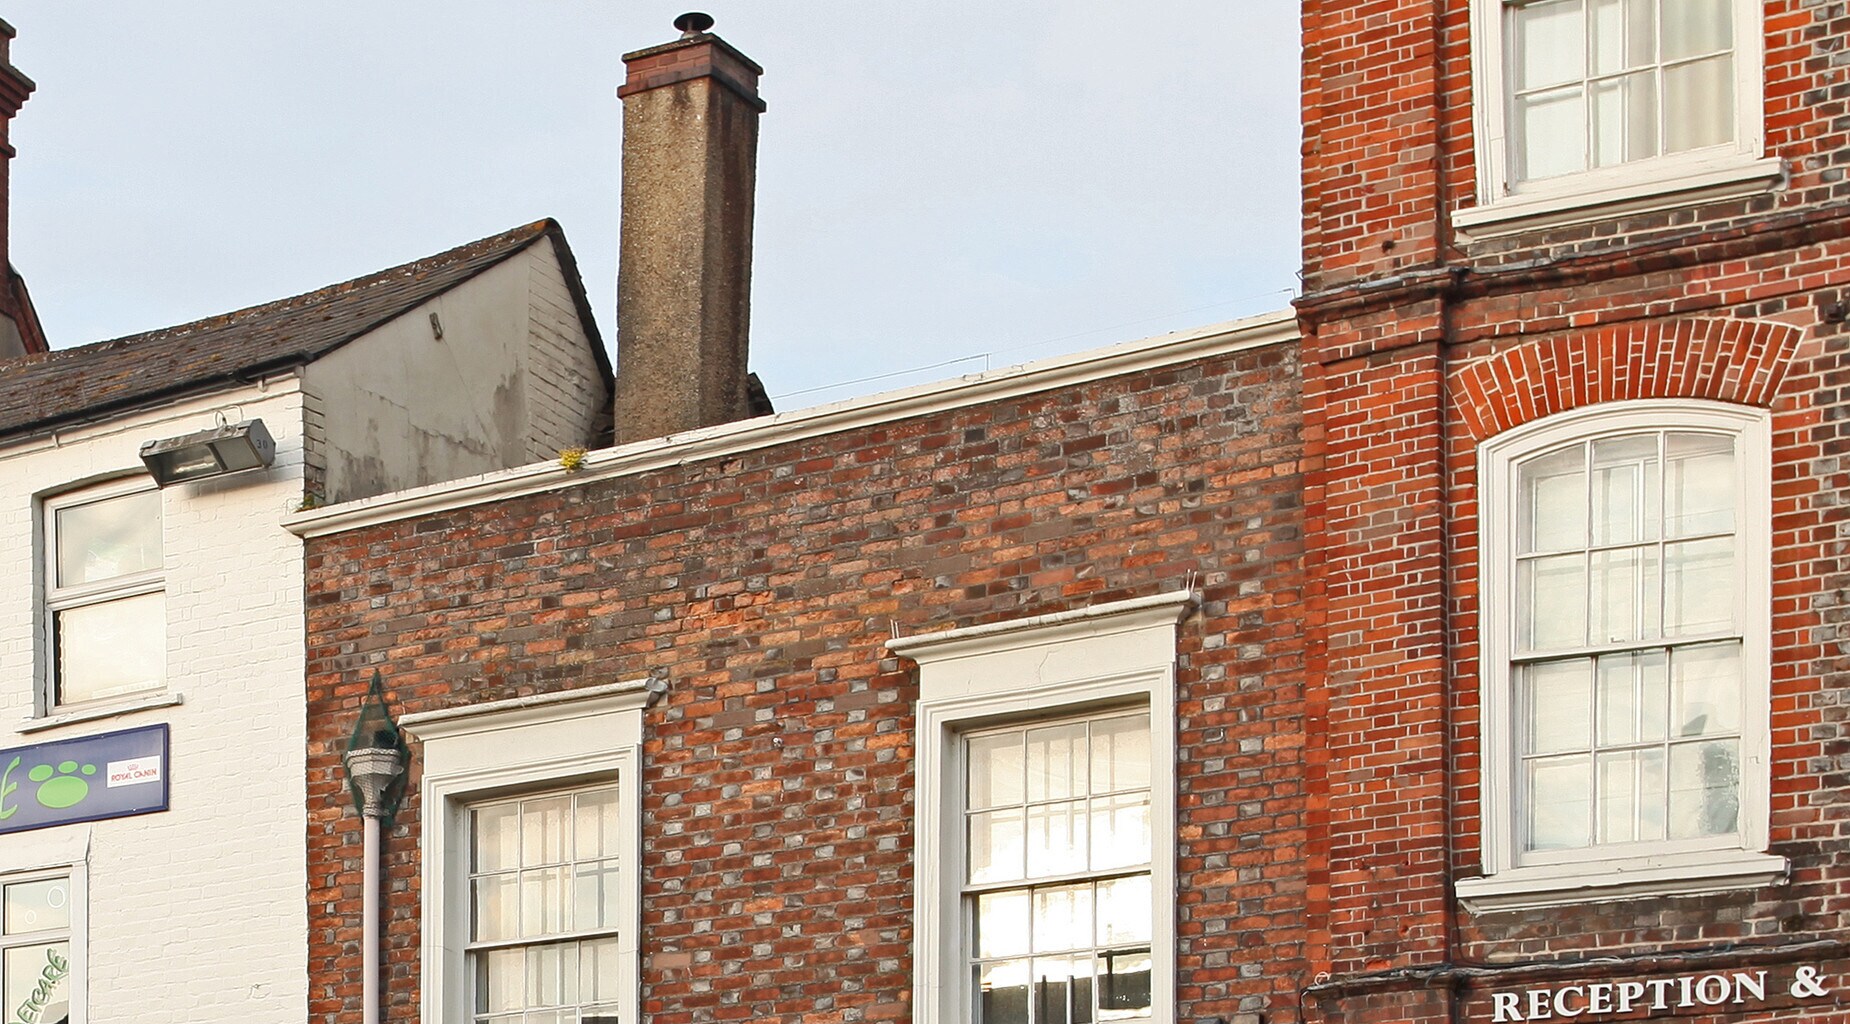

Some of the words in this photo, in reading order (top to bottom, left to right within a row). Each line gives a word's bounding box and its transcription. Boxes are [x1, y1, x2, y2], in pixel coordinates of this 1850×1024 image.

[111, 773, 133, 781] ROYAL
[133, 768, 157, 778] CANIN
[1491, 970, 1768, 1023] RECEPTION
[1790, 965, 1829, 998] &
